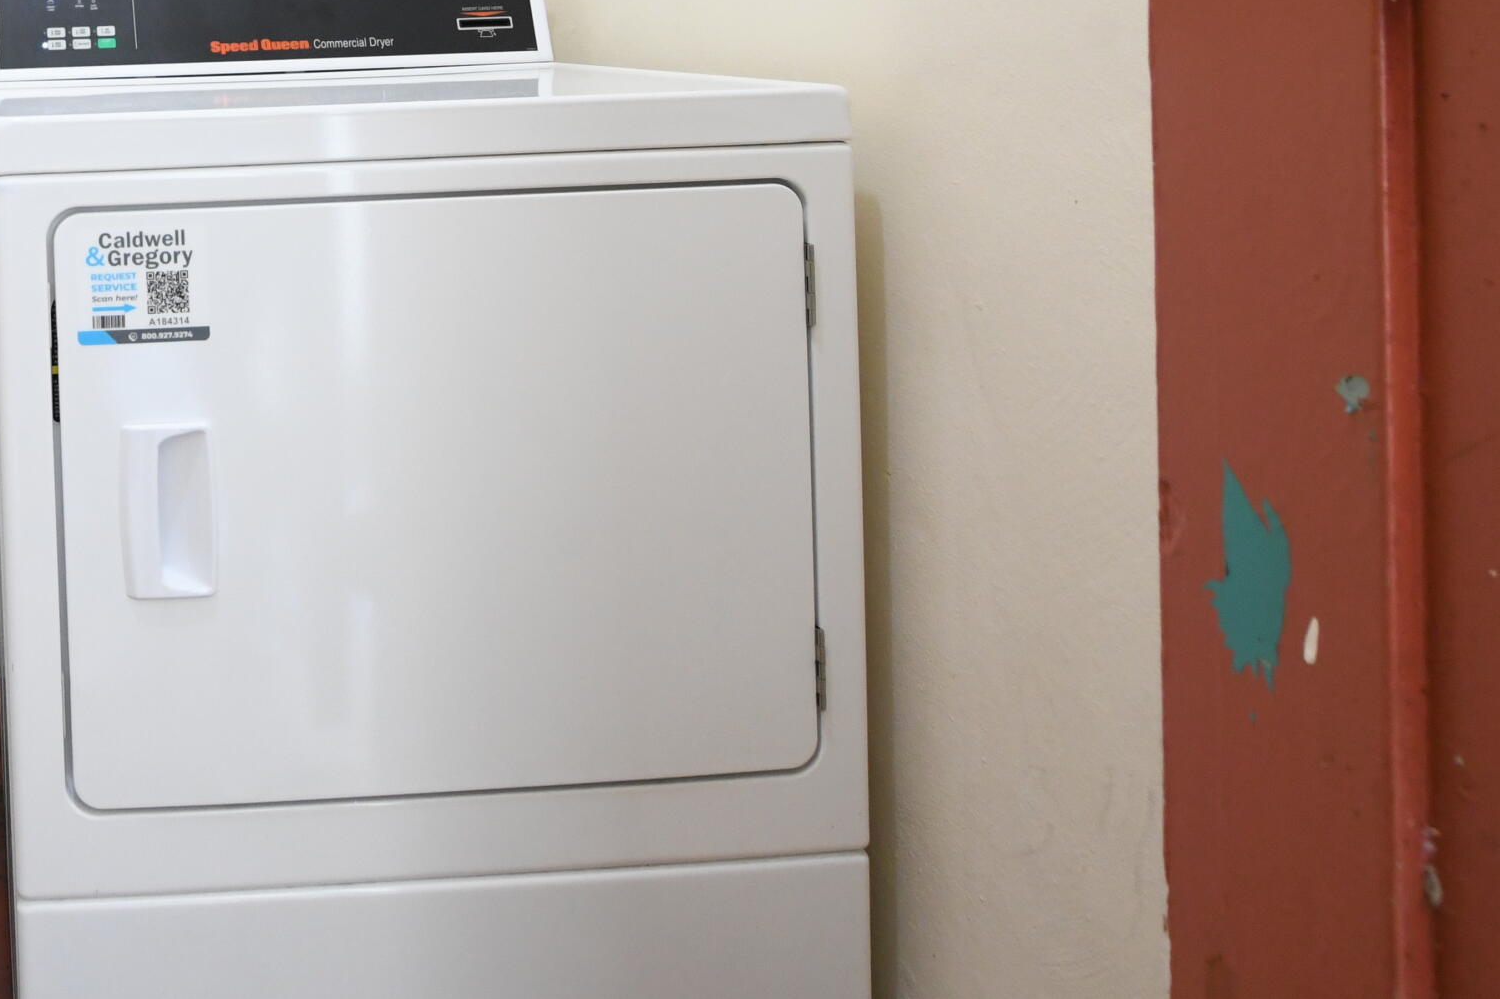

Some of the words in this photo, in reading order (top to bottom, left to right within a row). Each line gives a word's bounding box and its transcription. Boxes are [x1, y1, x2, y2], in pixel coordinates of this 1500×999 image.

[210, 39, 259, 56] Speed
[260, 38, 310, 50] Queen
[313, 37, 367, 49] Commercial
[369, 36, 394, 49] Dryer
[98, 229, 186, 249] Caldwell
[91, 272, 137, 282] REQUEST
[91, 283, 137, 292] SERVICE
[149, 317, 190, 326] A184314
[141, 331, 193, 340] 800.927.9274
